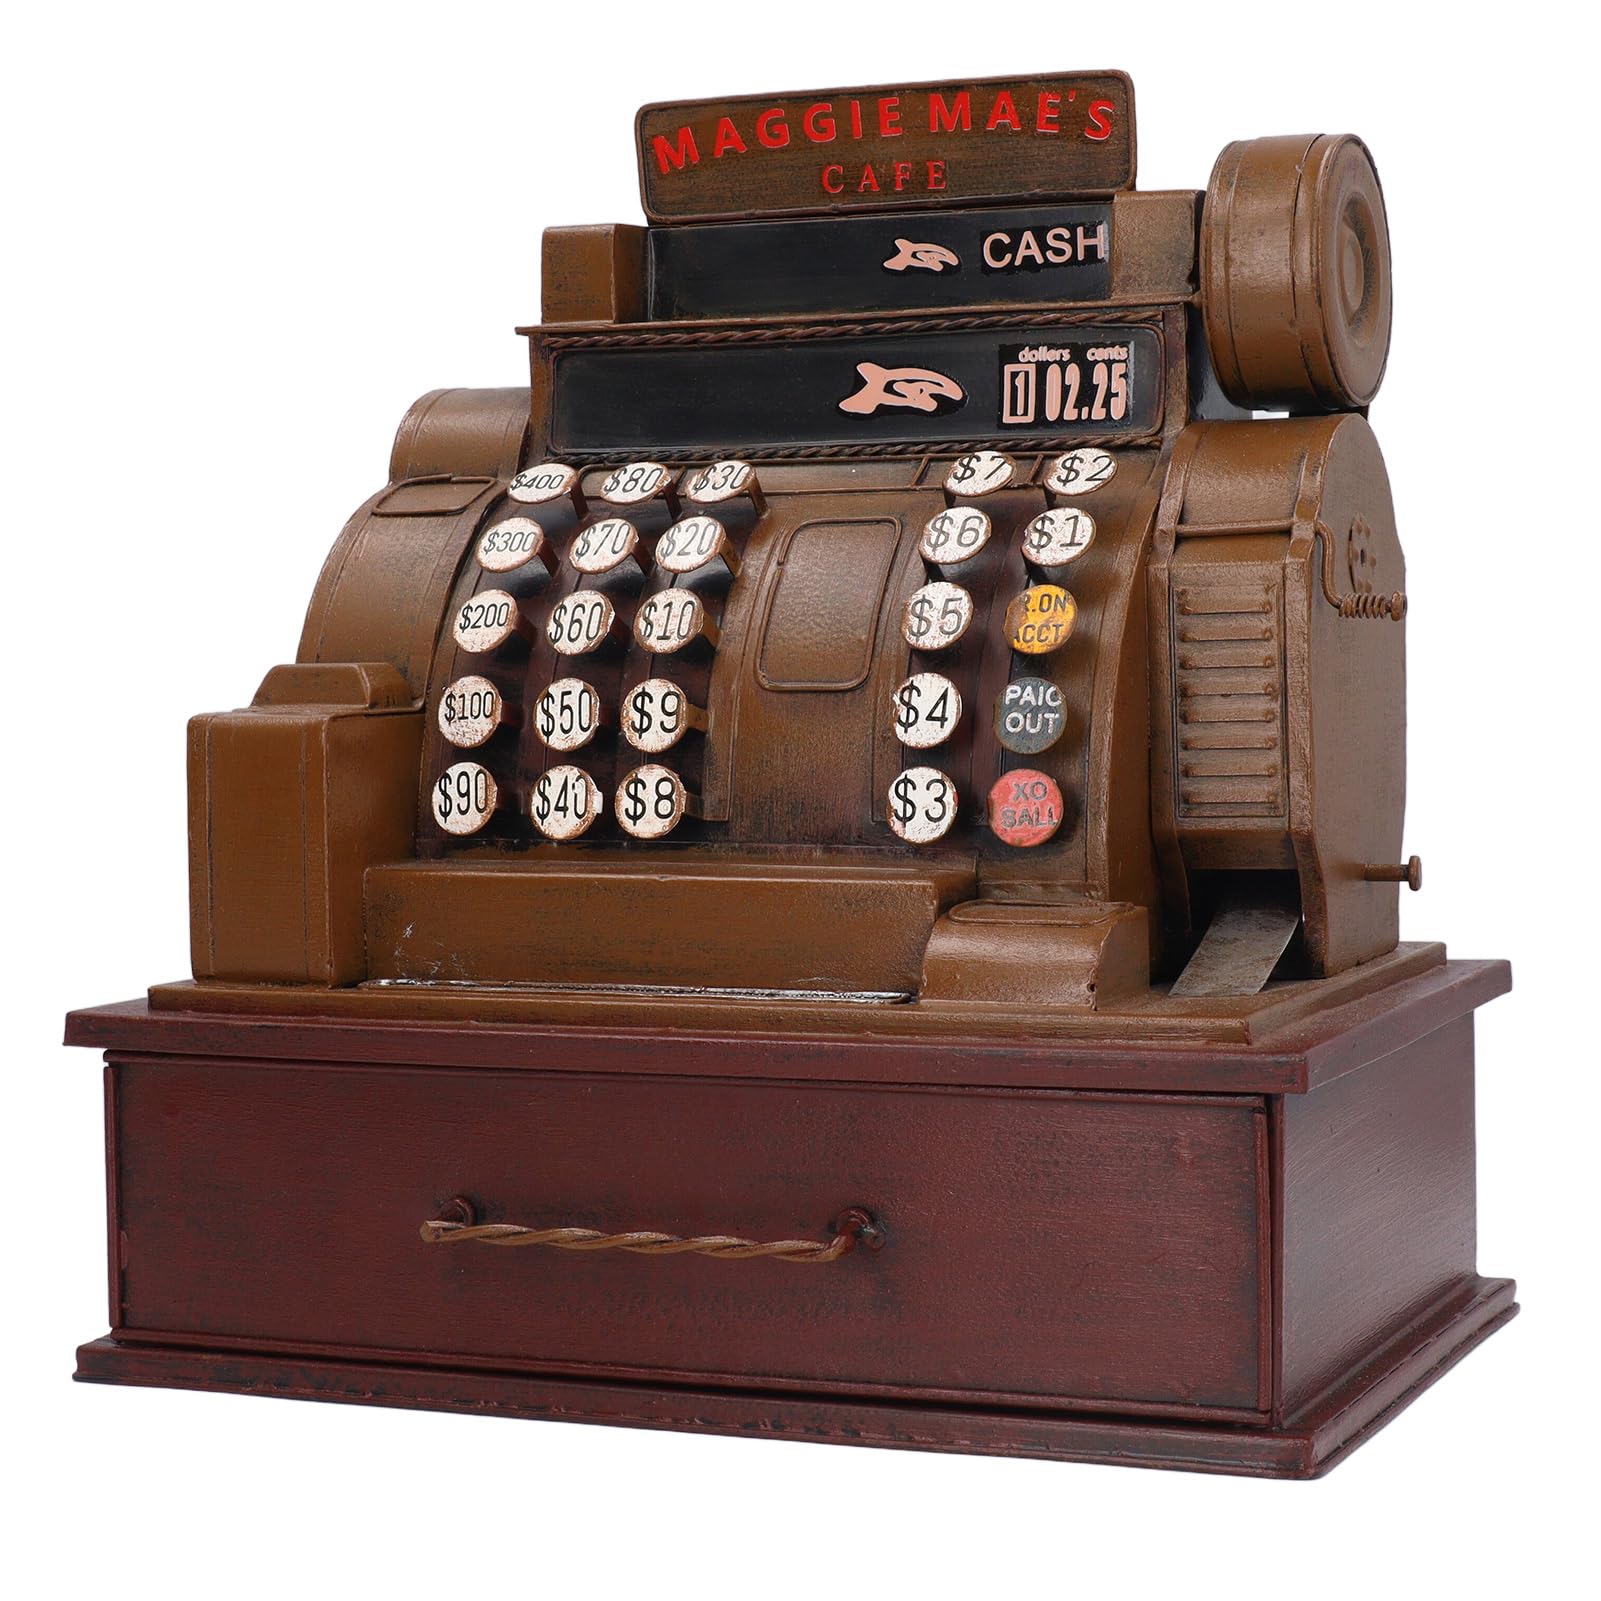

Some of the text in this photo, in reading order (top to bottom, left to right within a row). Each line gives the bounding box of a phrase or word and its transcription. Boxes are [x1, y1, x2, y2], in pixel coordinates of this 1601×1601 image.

[652, 91, 1116, 174] MAGGIE MAE'S
[822, 161, 948, 194] CAFE
[983, 224, 1105, 268] CASH
[510, 473, 565, 491] $400
[603, 466, 664, 493] $80
[692, 463, 751, 495] $30
[952, 453, 1008, 483] $7
[1056, 454, 1113, 487] $2
[483, 529, 538, 556] $300
[575, 521, 630, 559] $70
[659, 519, 718, 559] $20
[926, 512, 983, 555] $6
[1028, 513, 1083, 551] $1
[459, 601, 510, 633] $200
[549, 600, 602, 646] $60
[641, 598, 696, 641] $10
[908, 594, 964, 641] $5
[444, 690, 494, 724] $100
[540, 688, 592, 742] $50
[631, 687, 680, 739] $9
[897, 680, 950, 734] $4
[1005, 711, 1060, 734] OUT
[438, 770, 488, 823] $90
[535, 775, 588, 824] $40
[624, 776, 675, 827] $8
[893, 774, 948, 824] $3
[1013, 781, 1048, 801] XO
